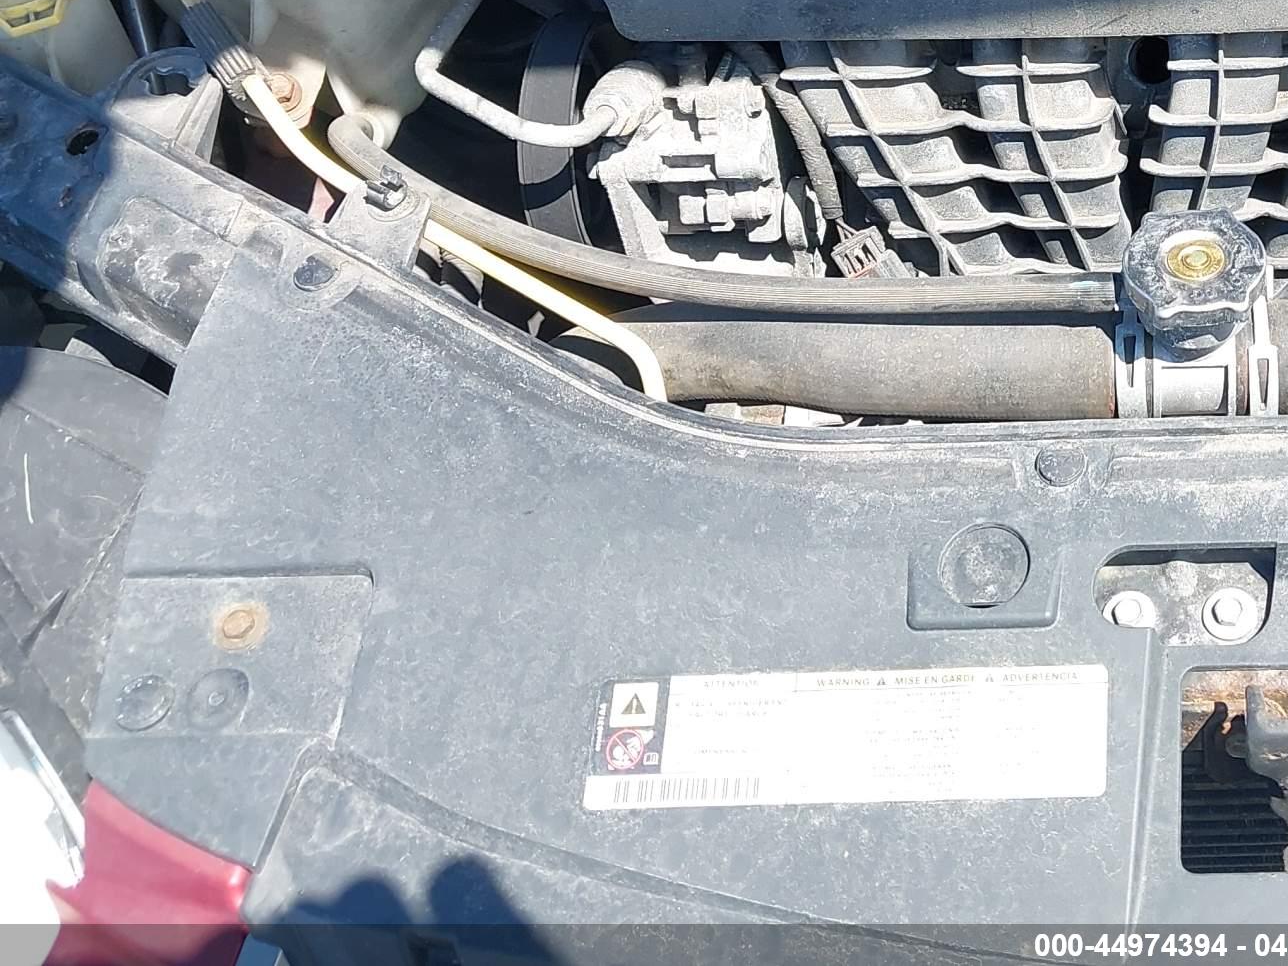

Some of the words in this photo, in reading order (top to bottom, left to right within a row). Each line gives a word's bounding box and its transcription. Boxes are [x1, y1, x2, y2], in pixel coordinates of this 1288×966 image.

[816, 678, 870, 687] WARNING
[894, 676, 921, 685] MISE
[924, 675, 938, 685] EN
